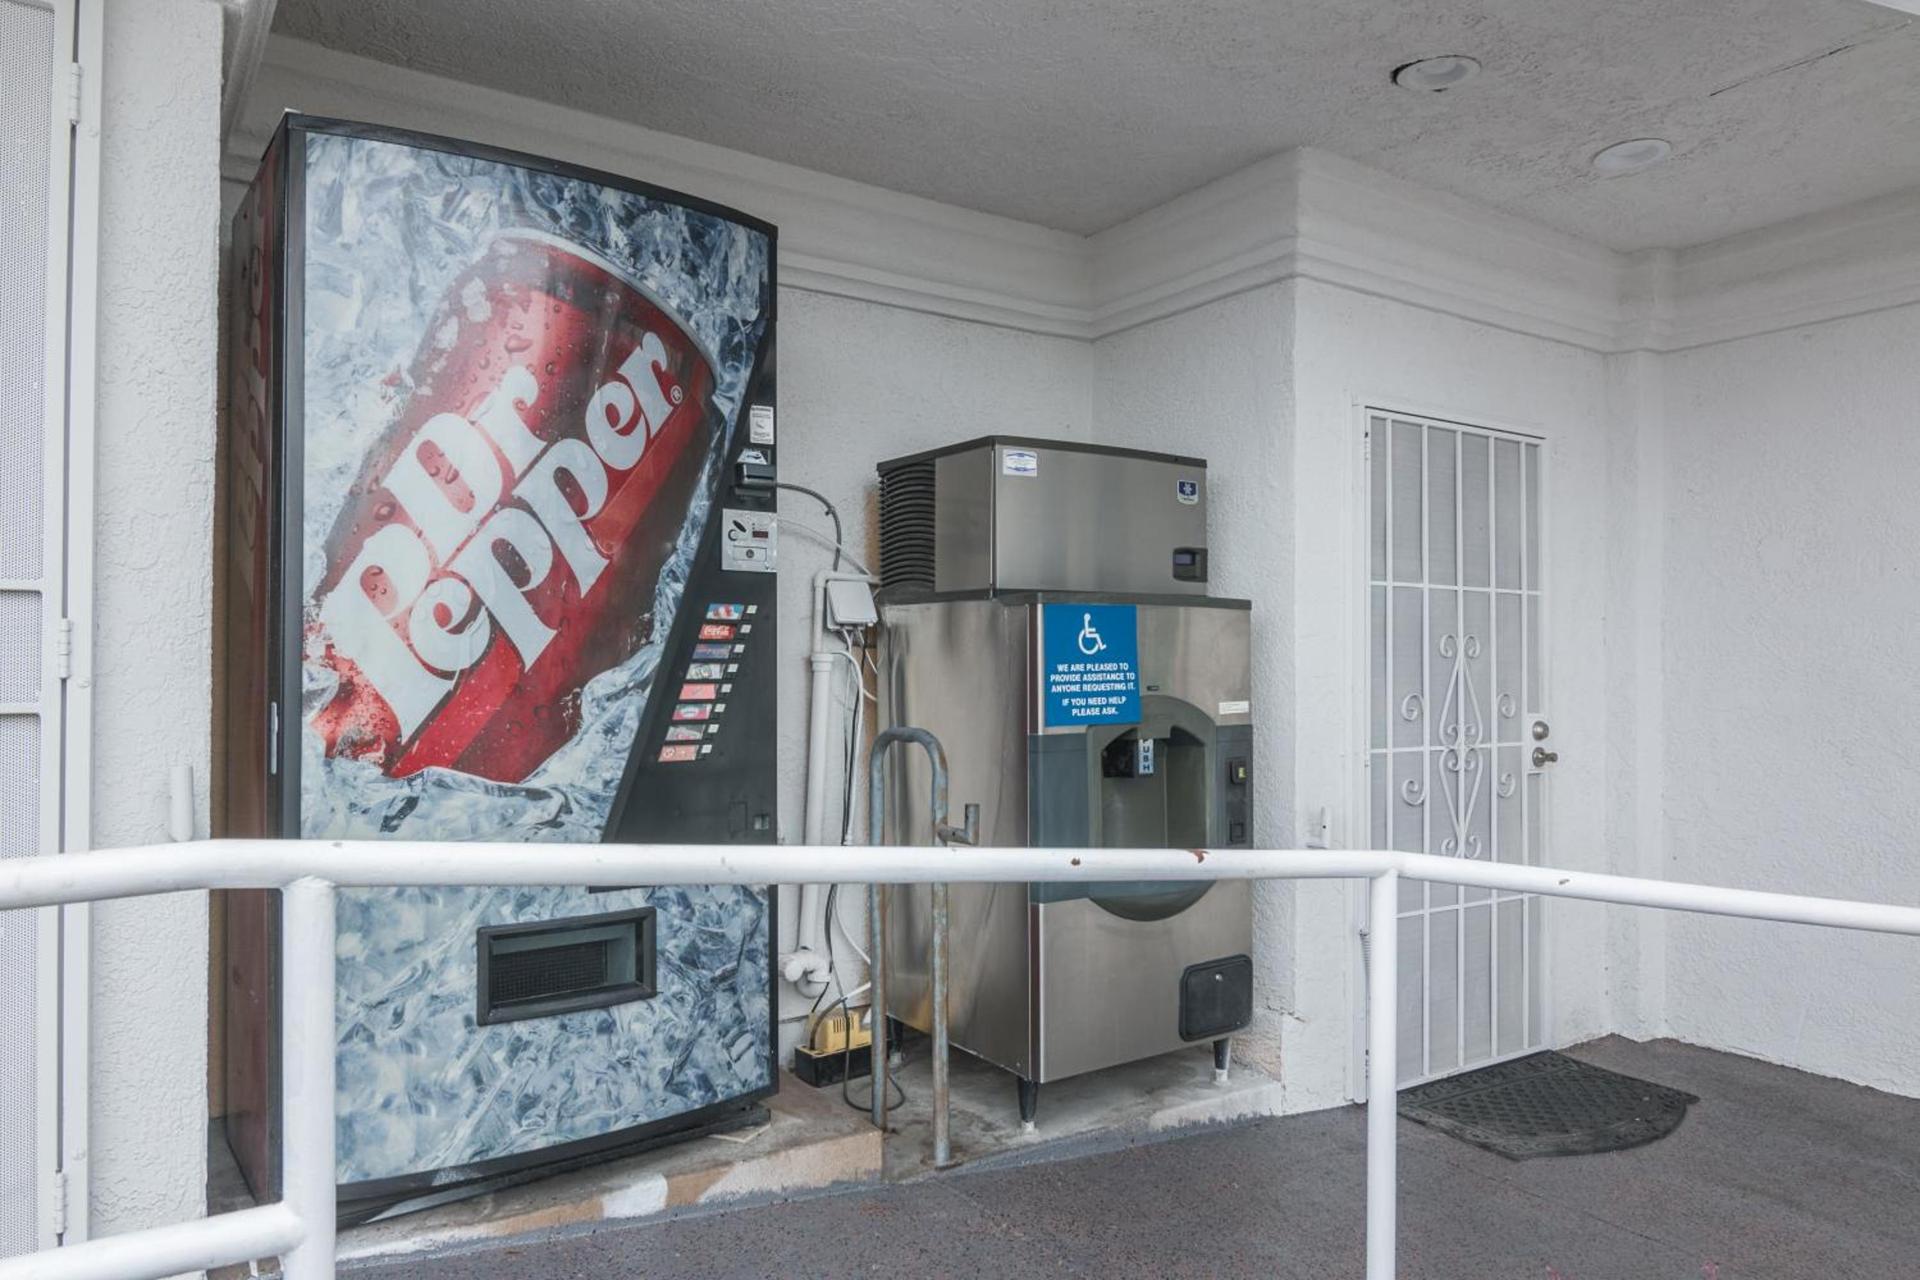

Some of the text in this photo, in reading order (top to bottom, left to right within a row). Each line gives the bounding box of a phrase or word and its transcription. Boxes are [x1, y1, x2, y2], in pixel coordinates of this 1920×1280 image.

[384, 365, 548, 569] Dr
[319, 331, 675, 746] Pepper
[1057, 662, 1129, 672] WE ARE PLEASED TO
[1050, 672, 1136, 682] PROVIDE ASSISTANCE TO
[1051, 684, 1081, 693] ANYONE
[1082, 683, 1126, 692] REQUESTING
[1062, 695, 1127, 706] IF YOU NEED HELP
[1072, 706, 1119, 716] PLEASE ASK.
